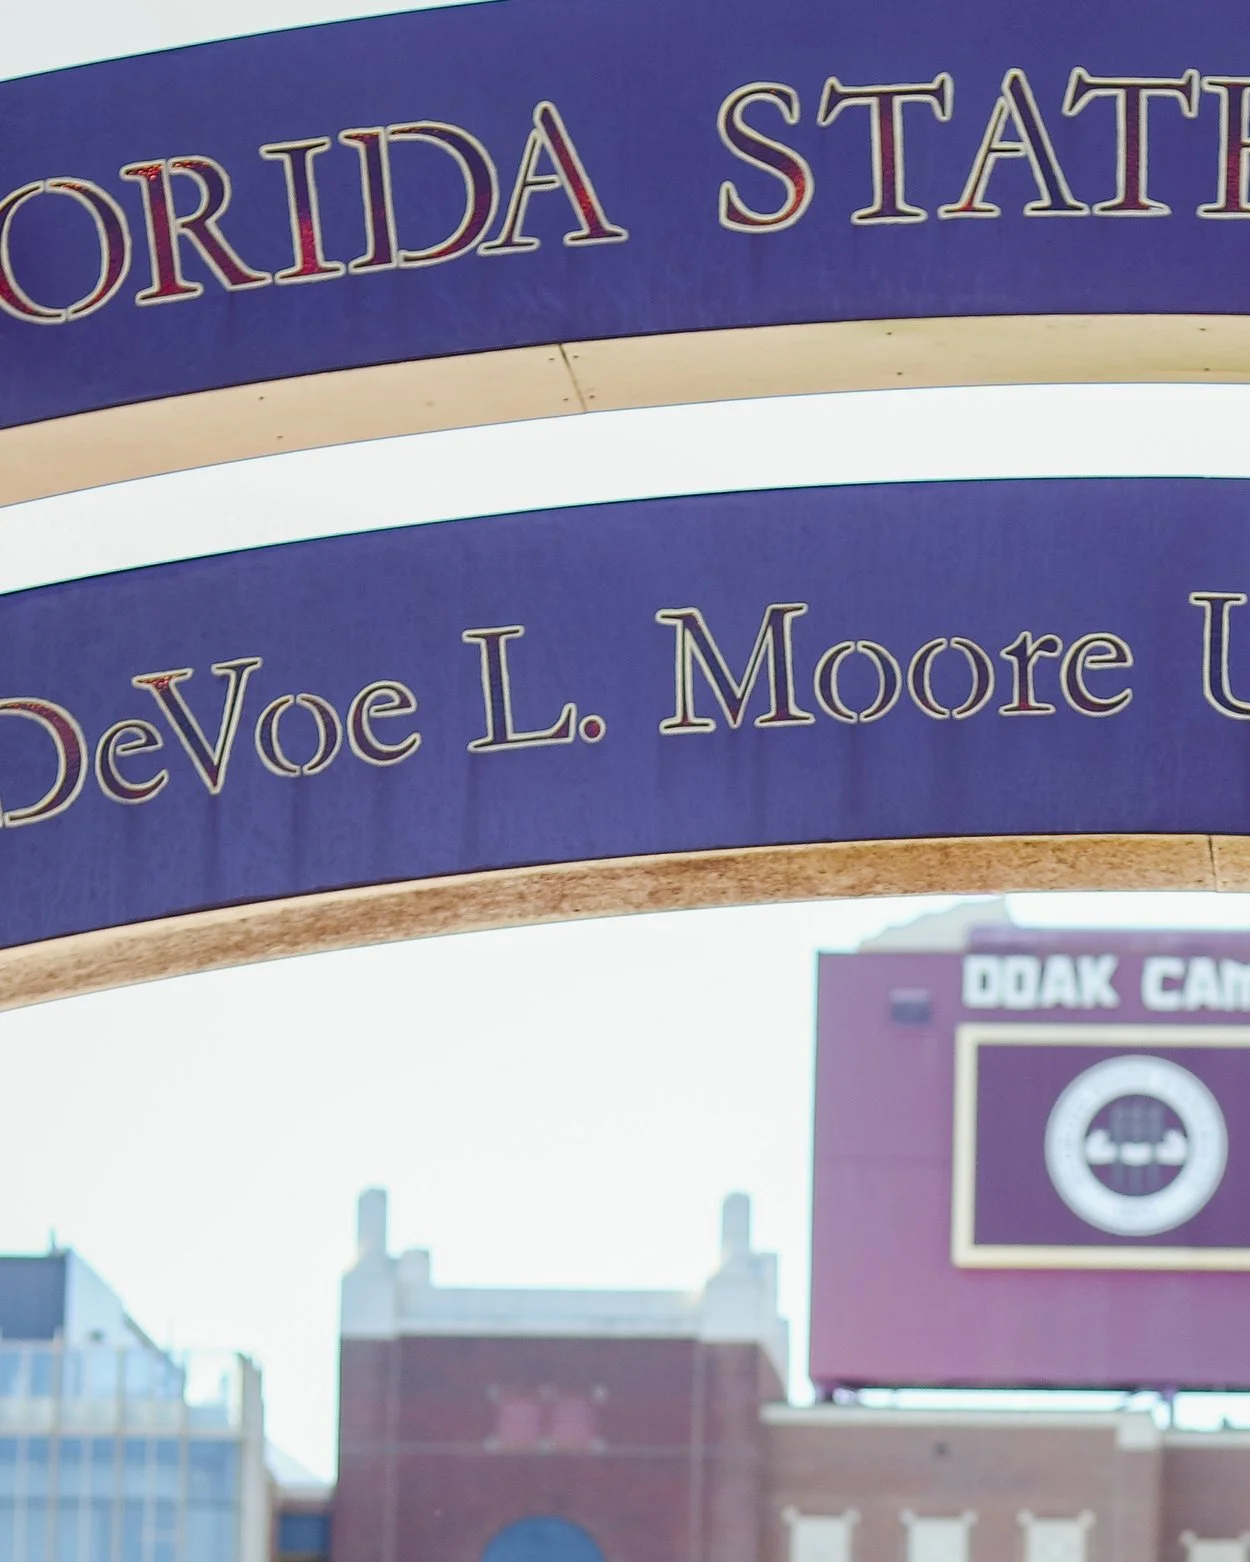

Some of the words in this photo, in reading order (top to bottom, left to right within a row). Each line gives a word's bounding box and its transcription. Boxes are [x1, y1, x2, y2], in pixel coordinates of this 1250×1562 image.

[0, 101, 629, 325] ORIDA
[0, 657, 422, 829] DeVoe
[462, 625, 607, 752] L.
[656, 603, 1134, 734] Moore
[962, 955, 1118, 1009] DOAK
